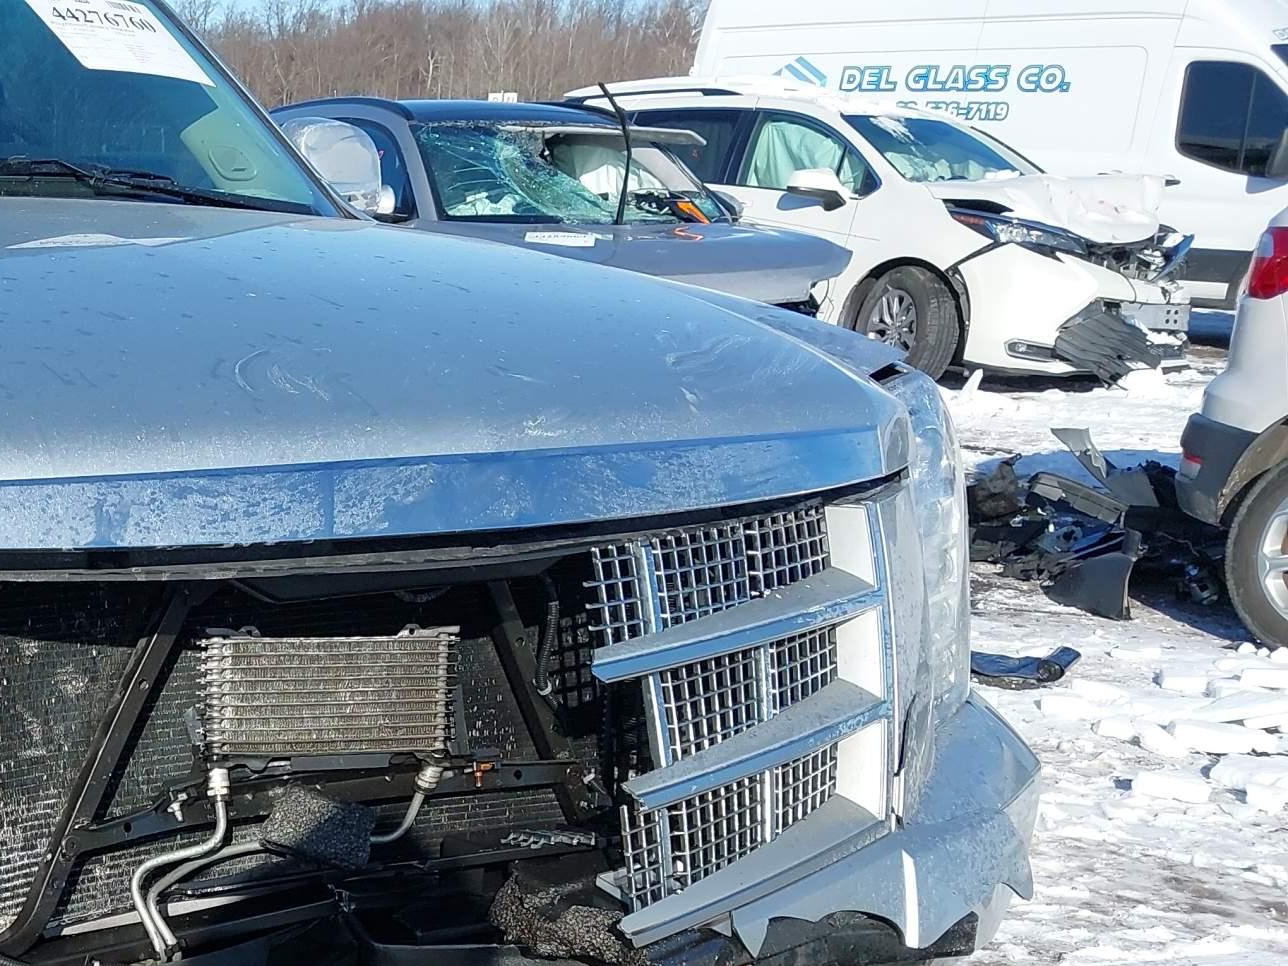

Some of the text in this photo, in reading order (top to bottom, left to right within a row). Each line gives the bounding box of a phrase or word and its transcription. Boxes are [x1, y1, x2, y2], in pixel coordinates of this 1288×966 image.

[52, 6, 157, 33] 44276760
[840, 65, 1071, 92] DEL GLASS CO.
